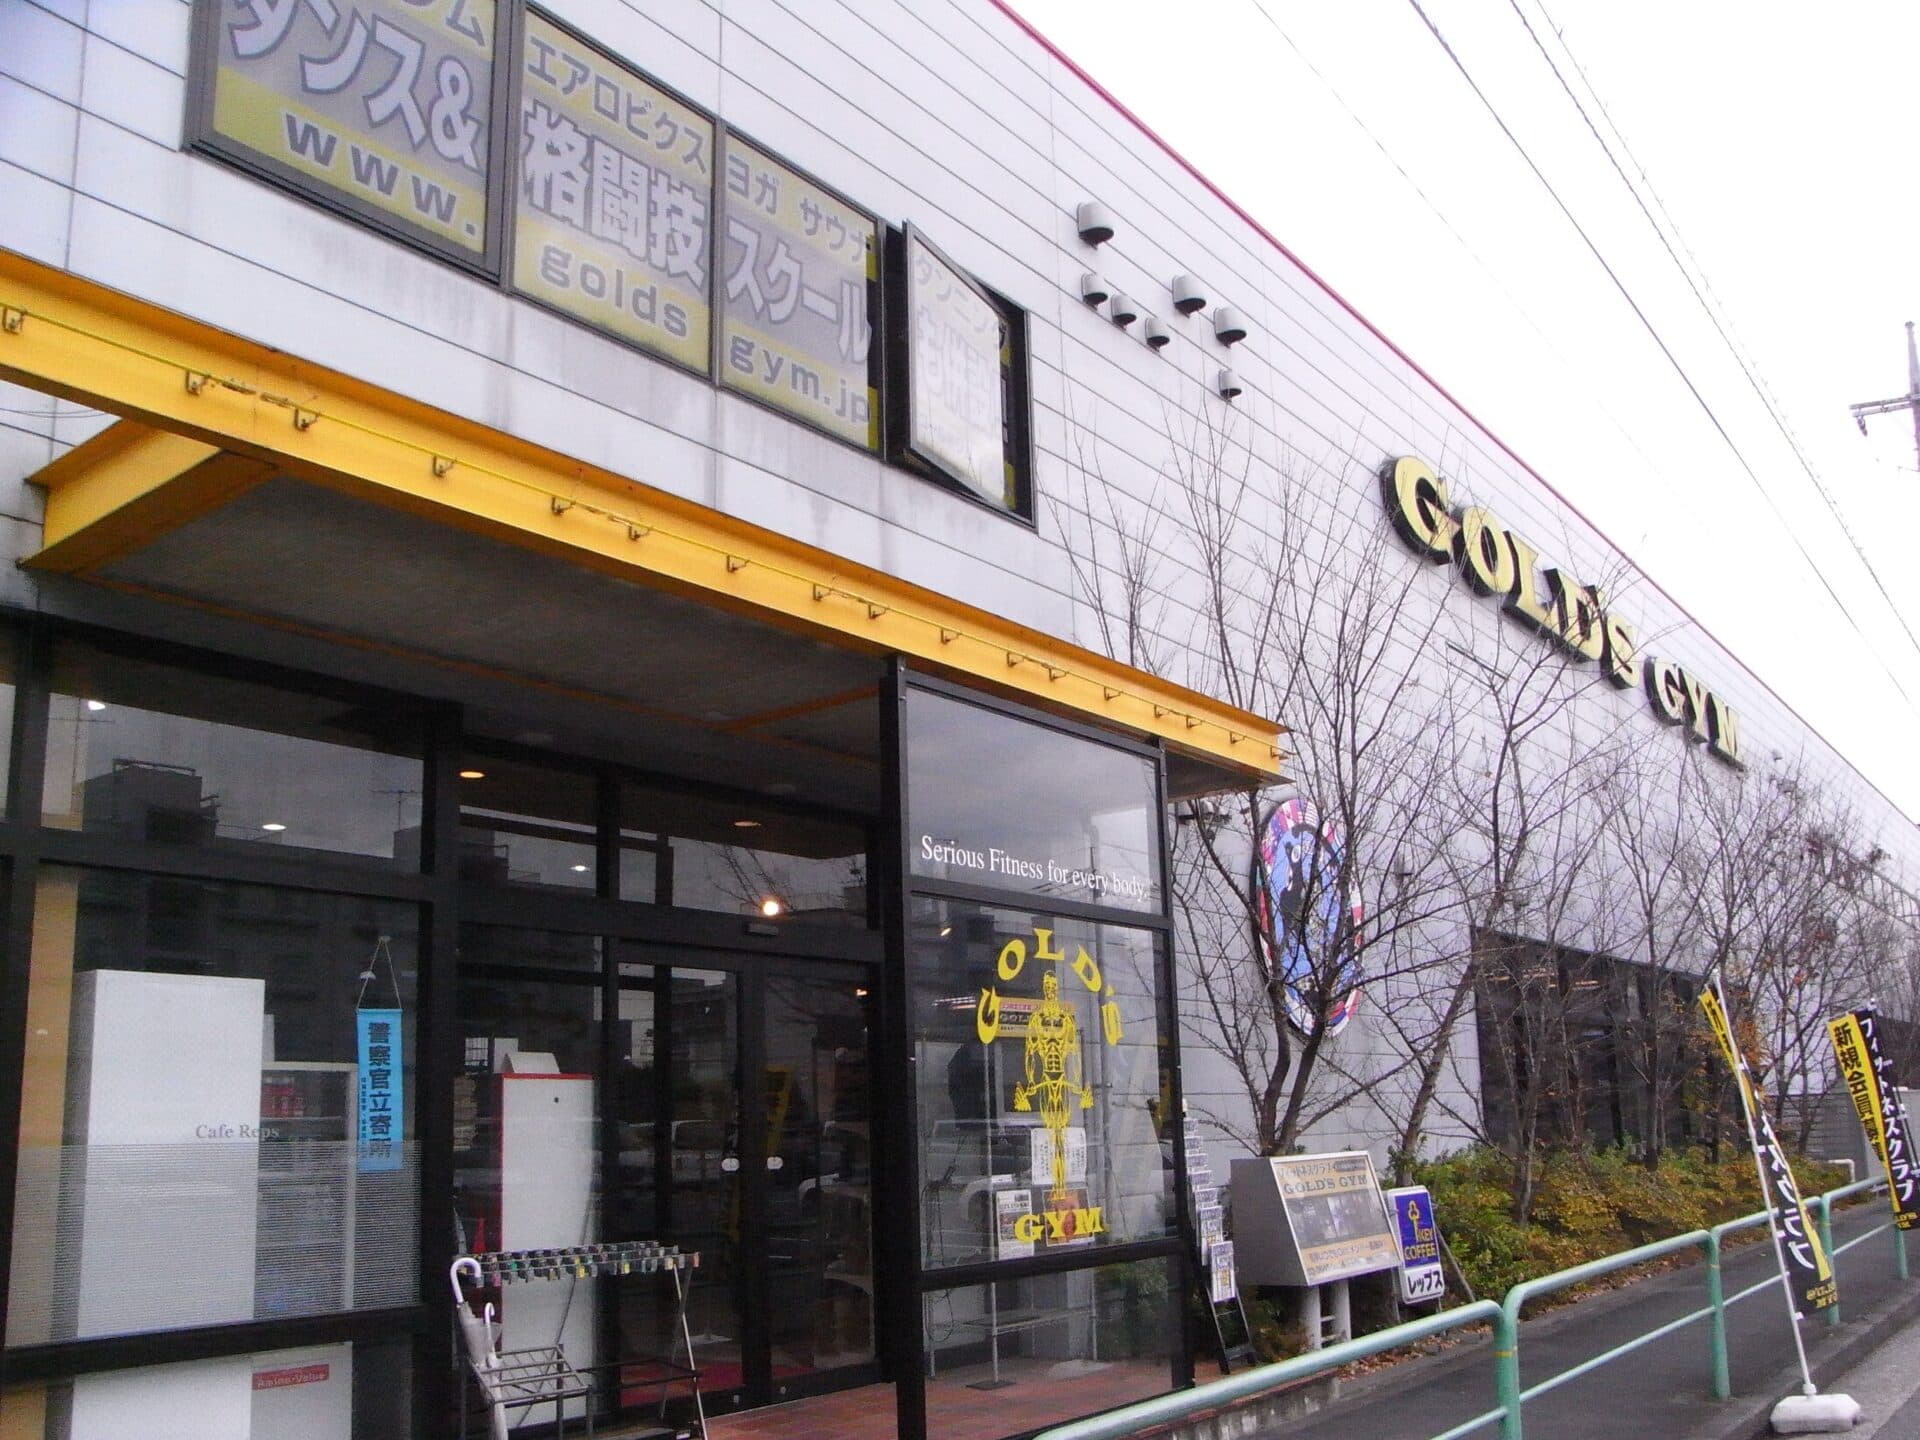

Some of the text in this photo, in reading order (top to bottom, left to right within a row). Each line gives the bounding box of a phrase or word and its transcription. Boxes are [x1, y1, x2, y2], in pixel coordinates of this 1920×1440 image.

[528, 36, 707, 174] エアロビクス
[728, 153, 778, 214] ヨガ
[523, 99, 707, 292] 格闘技
[724, 217, 871, 363] スクール
[541, 243, 688, 339] golds
[730, 334, 870, 424] gym.jp
[1645, 656, 1743, 770] GYM
[921, 835, 985, 869] Serious
[989, 848, 1043, 880] Fitness
[1047, 859, 1068, 885] for
[1072, 869, 1108, 896] every
[196, 1124, 233, 1139] Cafe
[1860, 1018, 1914, 1201] フィットネスクラブ
[1284, 1174, 1368, 1193] GOLD'S GYM
[1015, 1207, 1104, 1244] GYM
[1417, 1228, 1434, 1241] KEY
[1405, 1243, 1436, 1260] COFFEE
[1408, 1270, 1443, 1295] レップス
